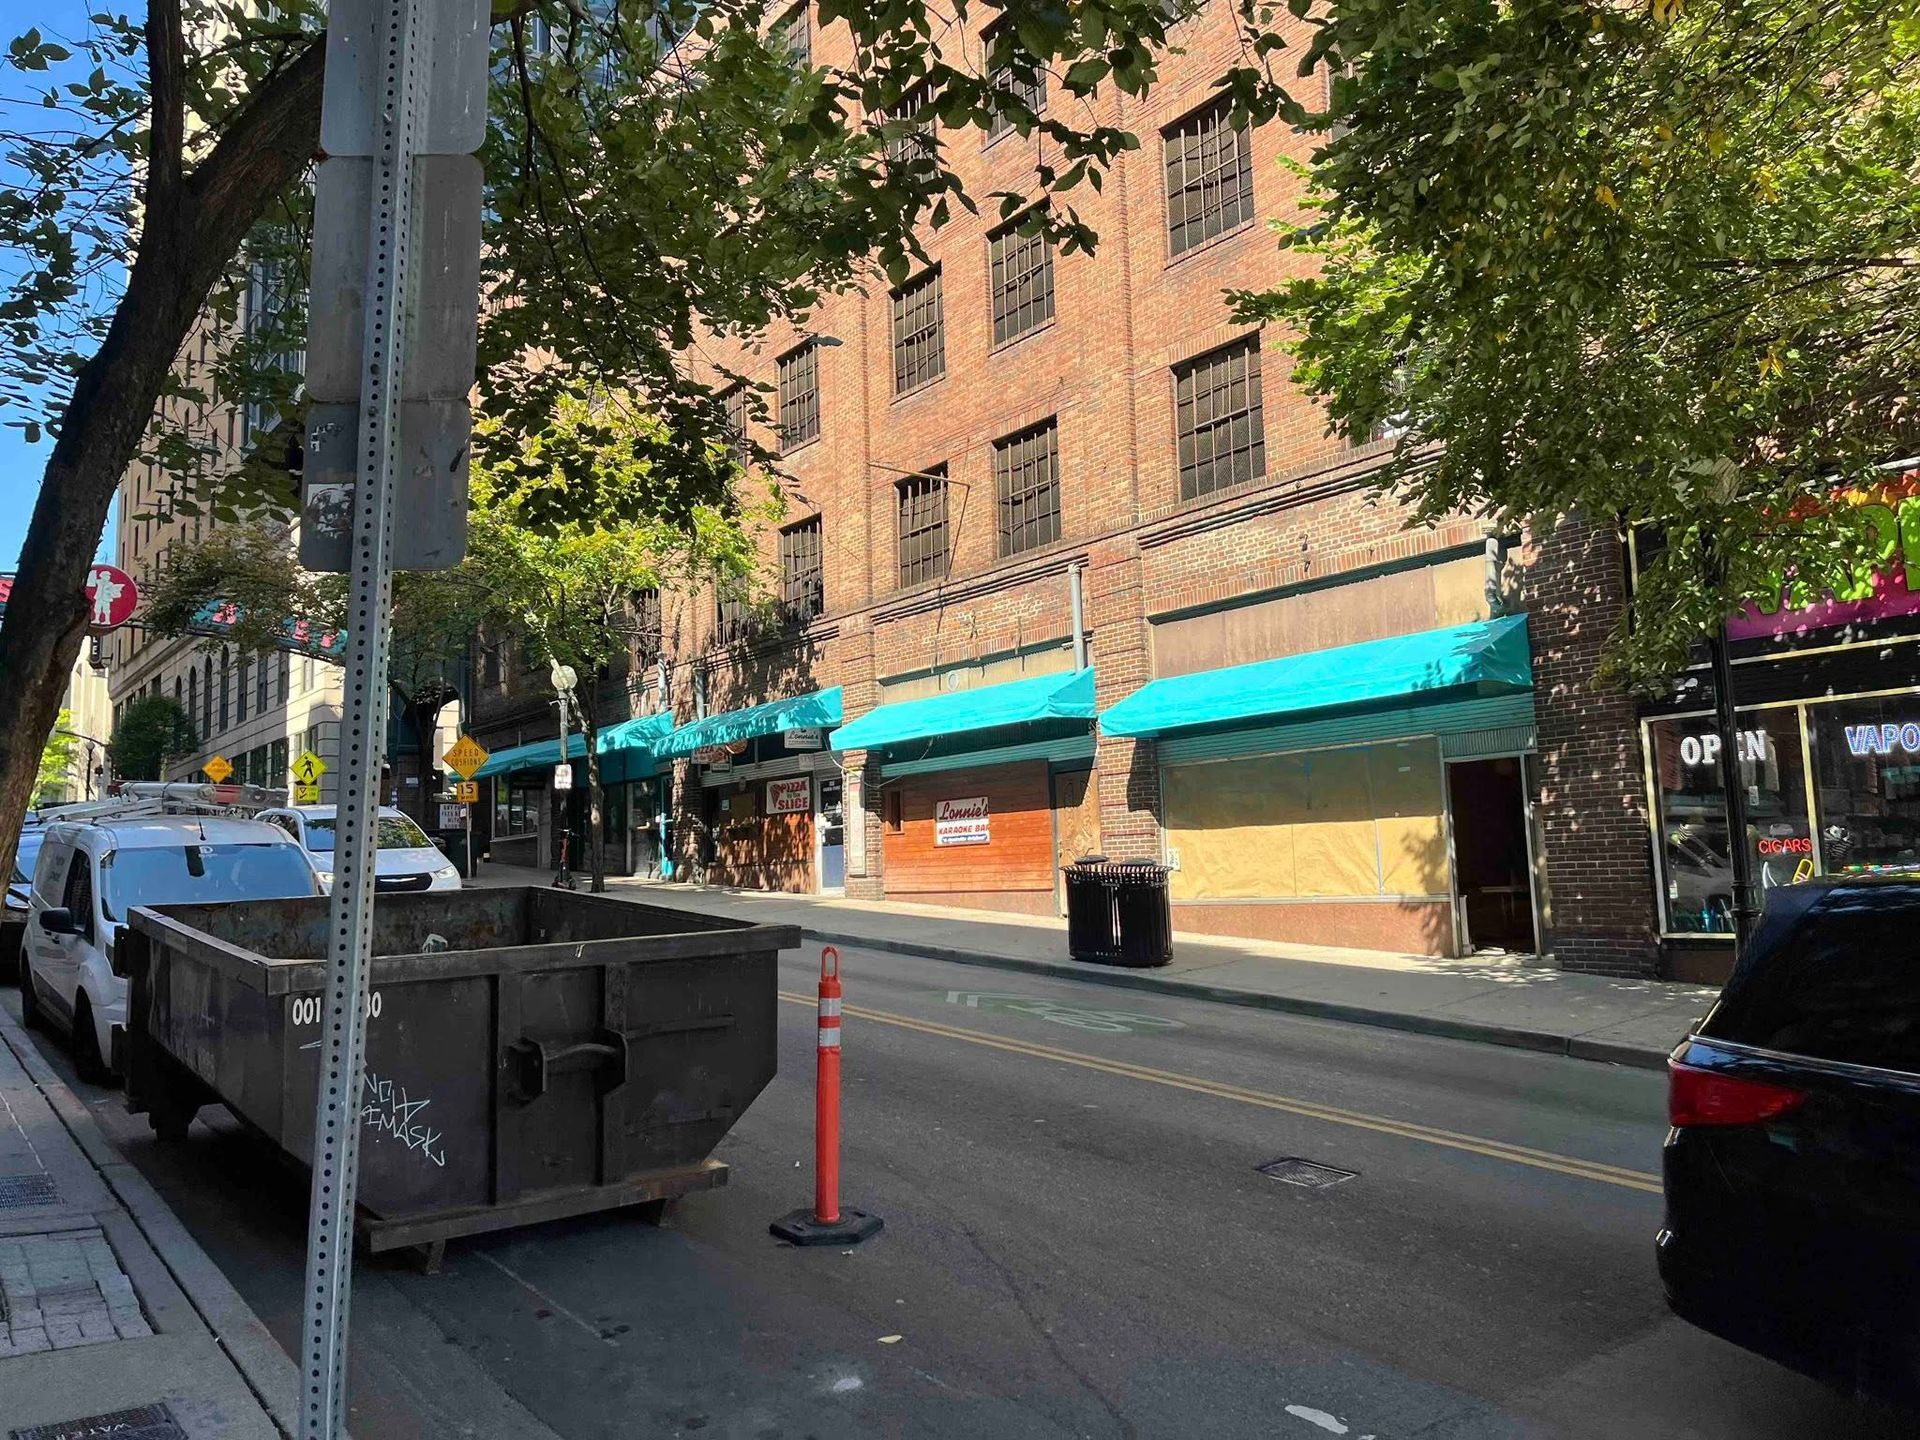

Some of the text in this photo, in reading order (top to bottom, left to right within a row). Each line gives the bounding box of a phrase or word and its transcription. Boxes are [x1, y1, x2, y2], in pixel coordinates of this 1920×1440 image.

[1845, 723, 1920, 755] VAPO
[453, 748, 479, 757] SPEED
[451, 757, 481, 766] CUSHIONS
[460, 783, 474, 795] 15
[780, 780, 807, 793] PIZZA
[777, 796, 808, 811] SLICE
[938, 798, 989, 820] Lonnie's
[938, 825, 973, 836] KARAOKE
[1758, 838, 1813, 854] CIGARS
